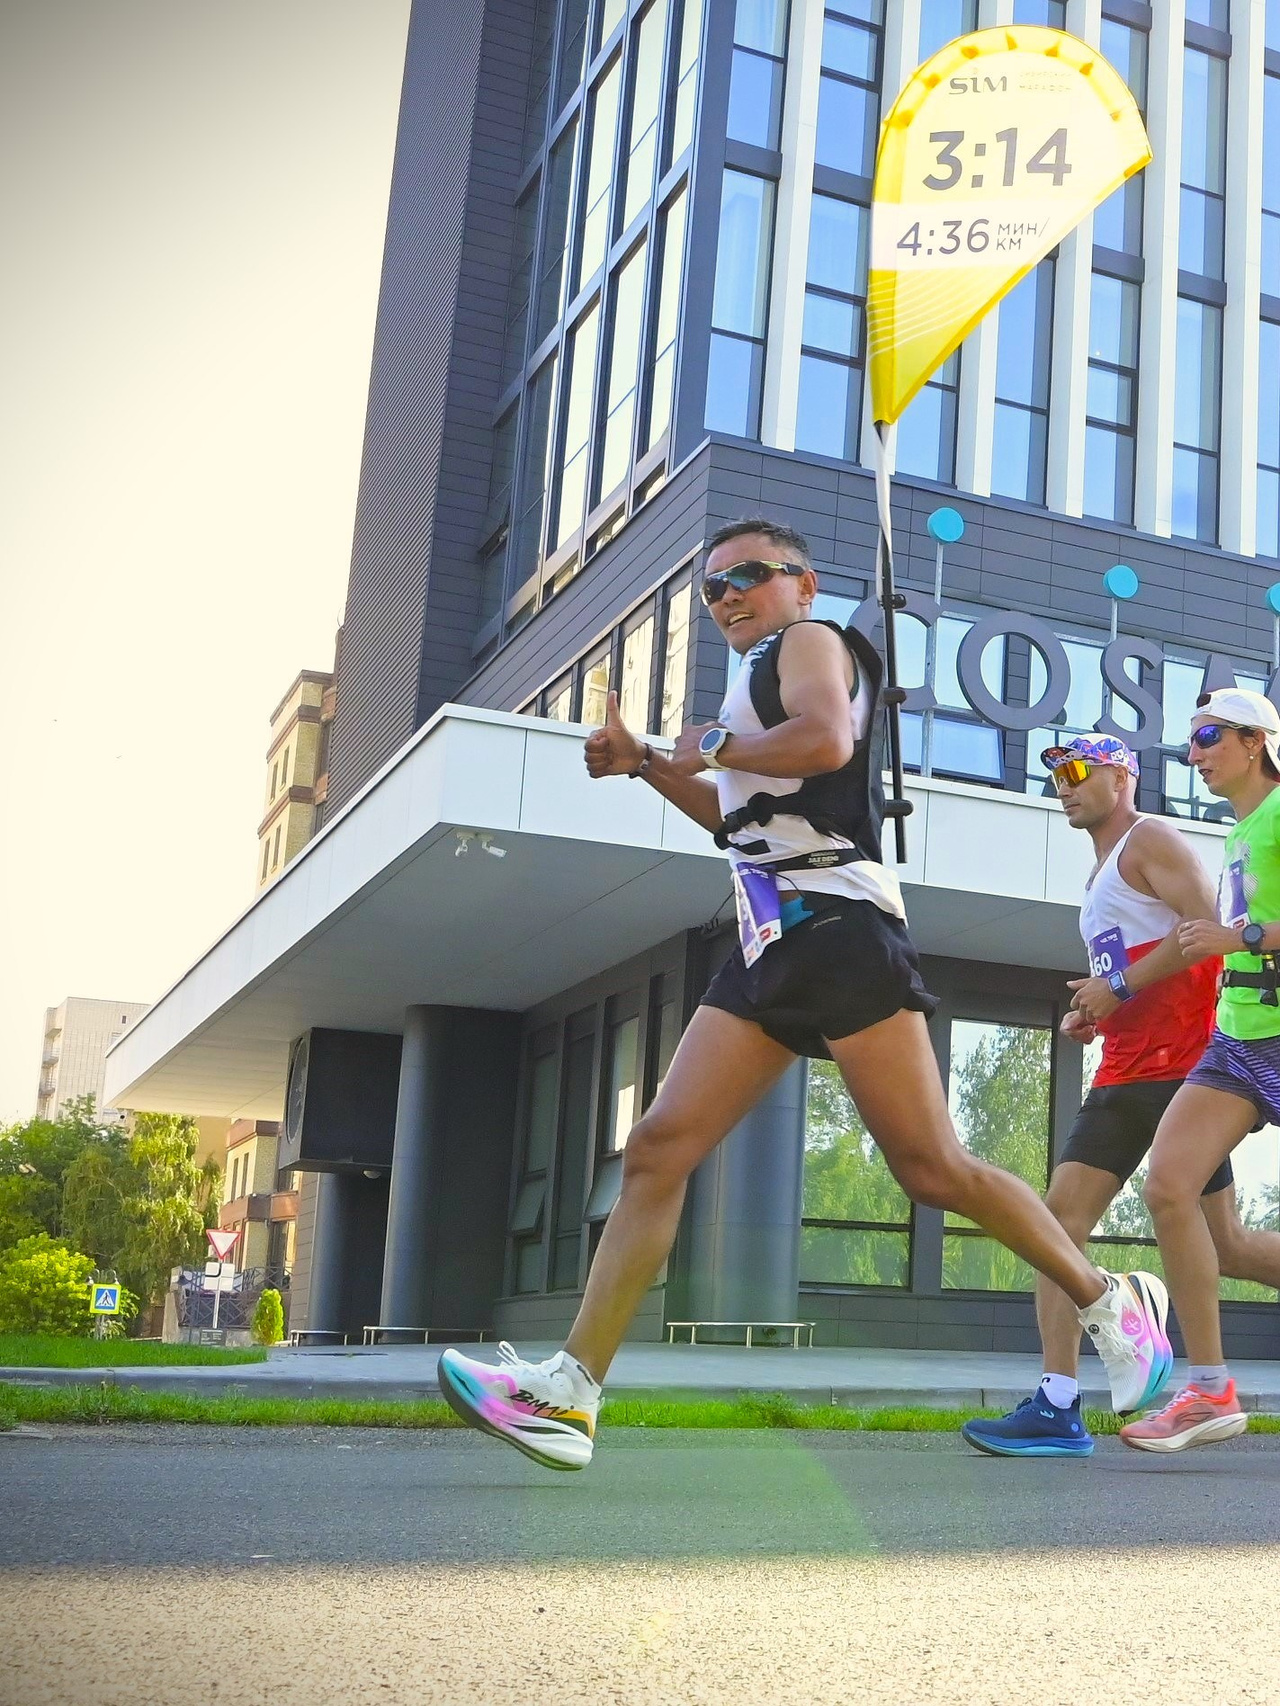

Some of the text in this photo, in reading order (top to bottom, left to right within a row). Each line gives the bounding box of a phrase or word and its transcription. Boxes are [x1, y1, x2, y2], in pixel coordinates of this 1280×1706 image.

[922, 128, 1072, 191] 3:14
[897, 219, 990, 256] 4:36
[1091, 952, 1112, 977] 60
